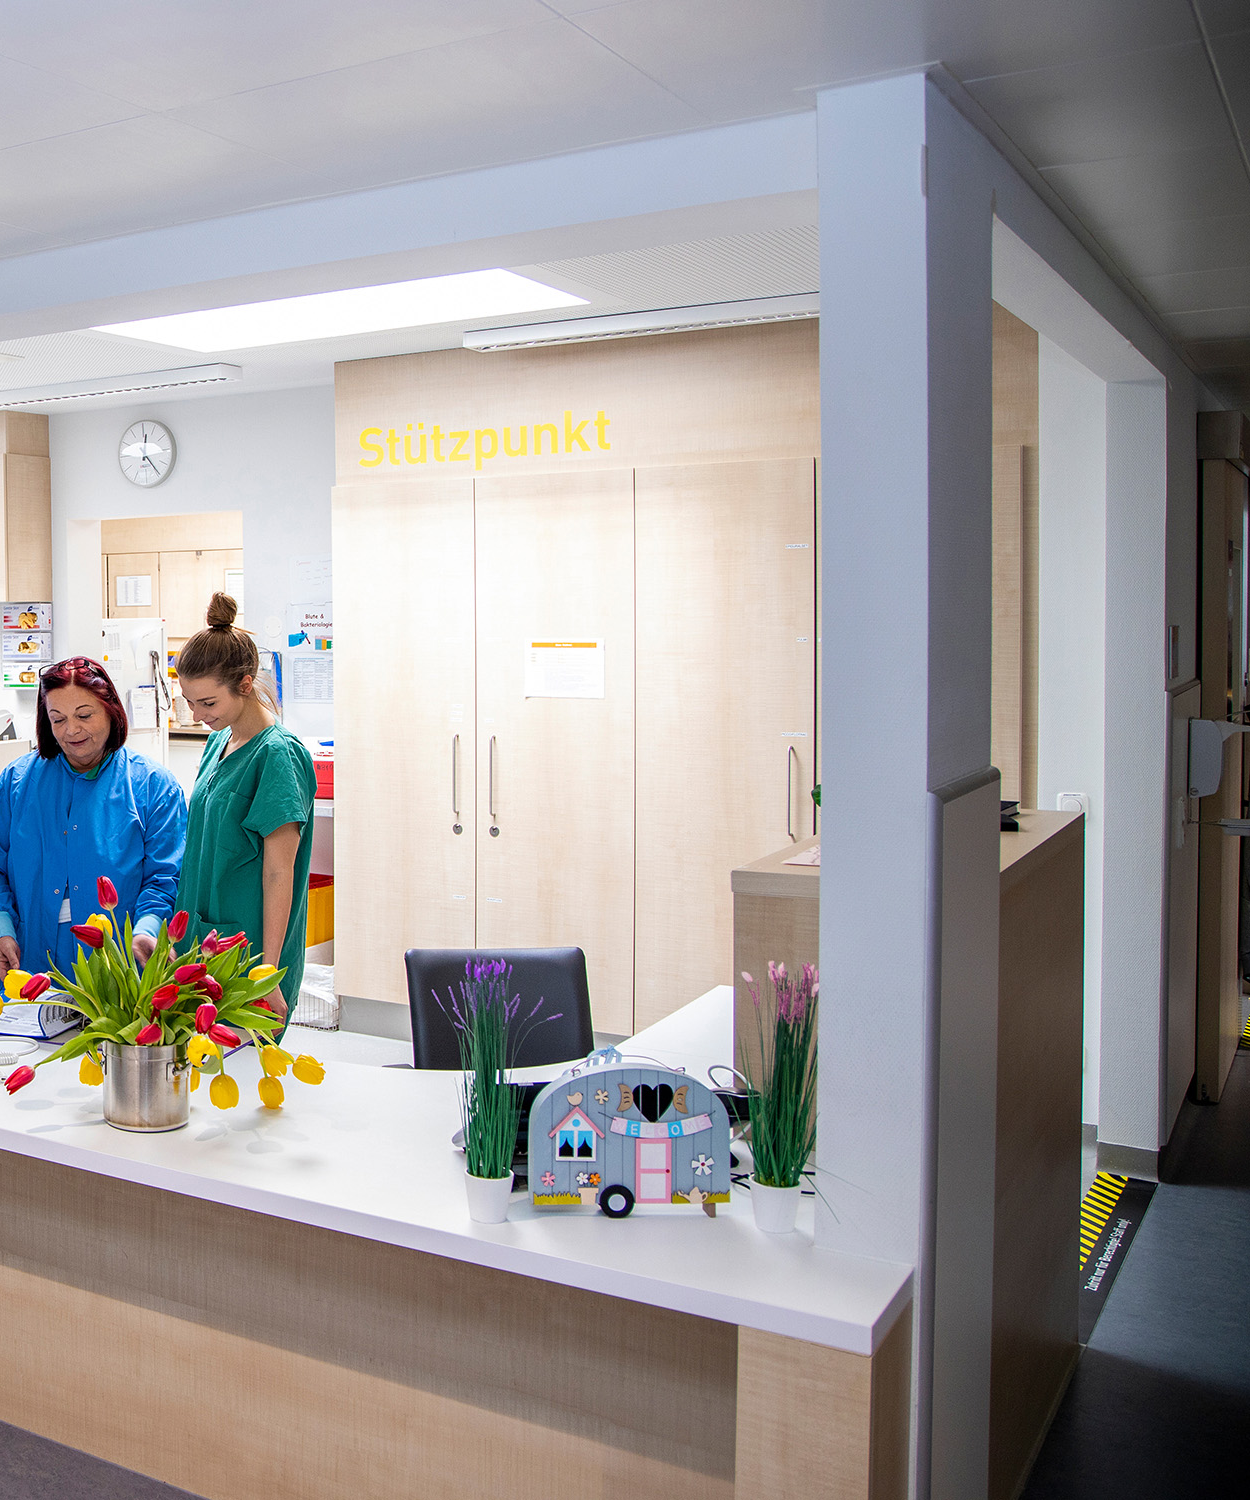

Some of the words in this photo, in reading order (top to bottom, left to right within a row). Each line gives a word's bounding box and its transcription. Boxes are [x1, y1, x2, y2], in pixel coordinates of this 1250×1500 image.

[358, 410, 612, 471] Stützpunkt
[613, 1118, 707, 1136] WELCOME
[1116, 1218, 1132, 1229] only!
[1110, 1227, 1125, 1238] Staff
[1098, 1236, 1122, 1262] Berechtigte!
[1095, 1260, 1109, 1268] für
[1094, 1268, 1106, 1277] nur
[1084, 1275, 1102, 1291] Zutritt
